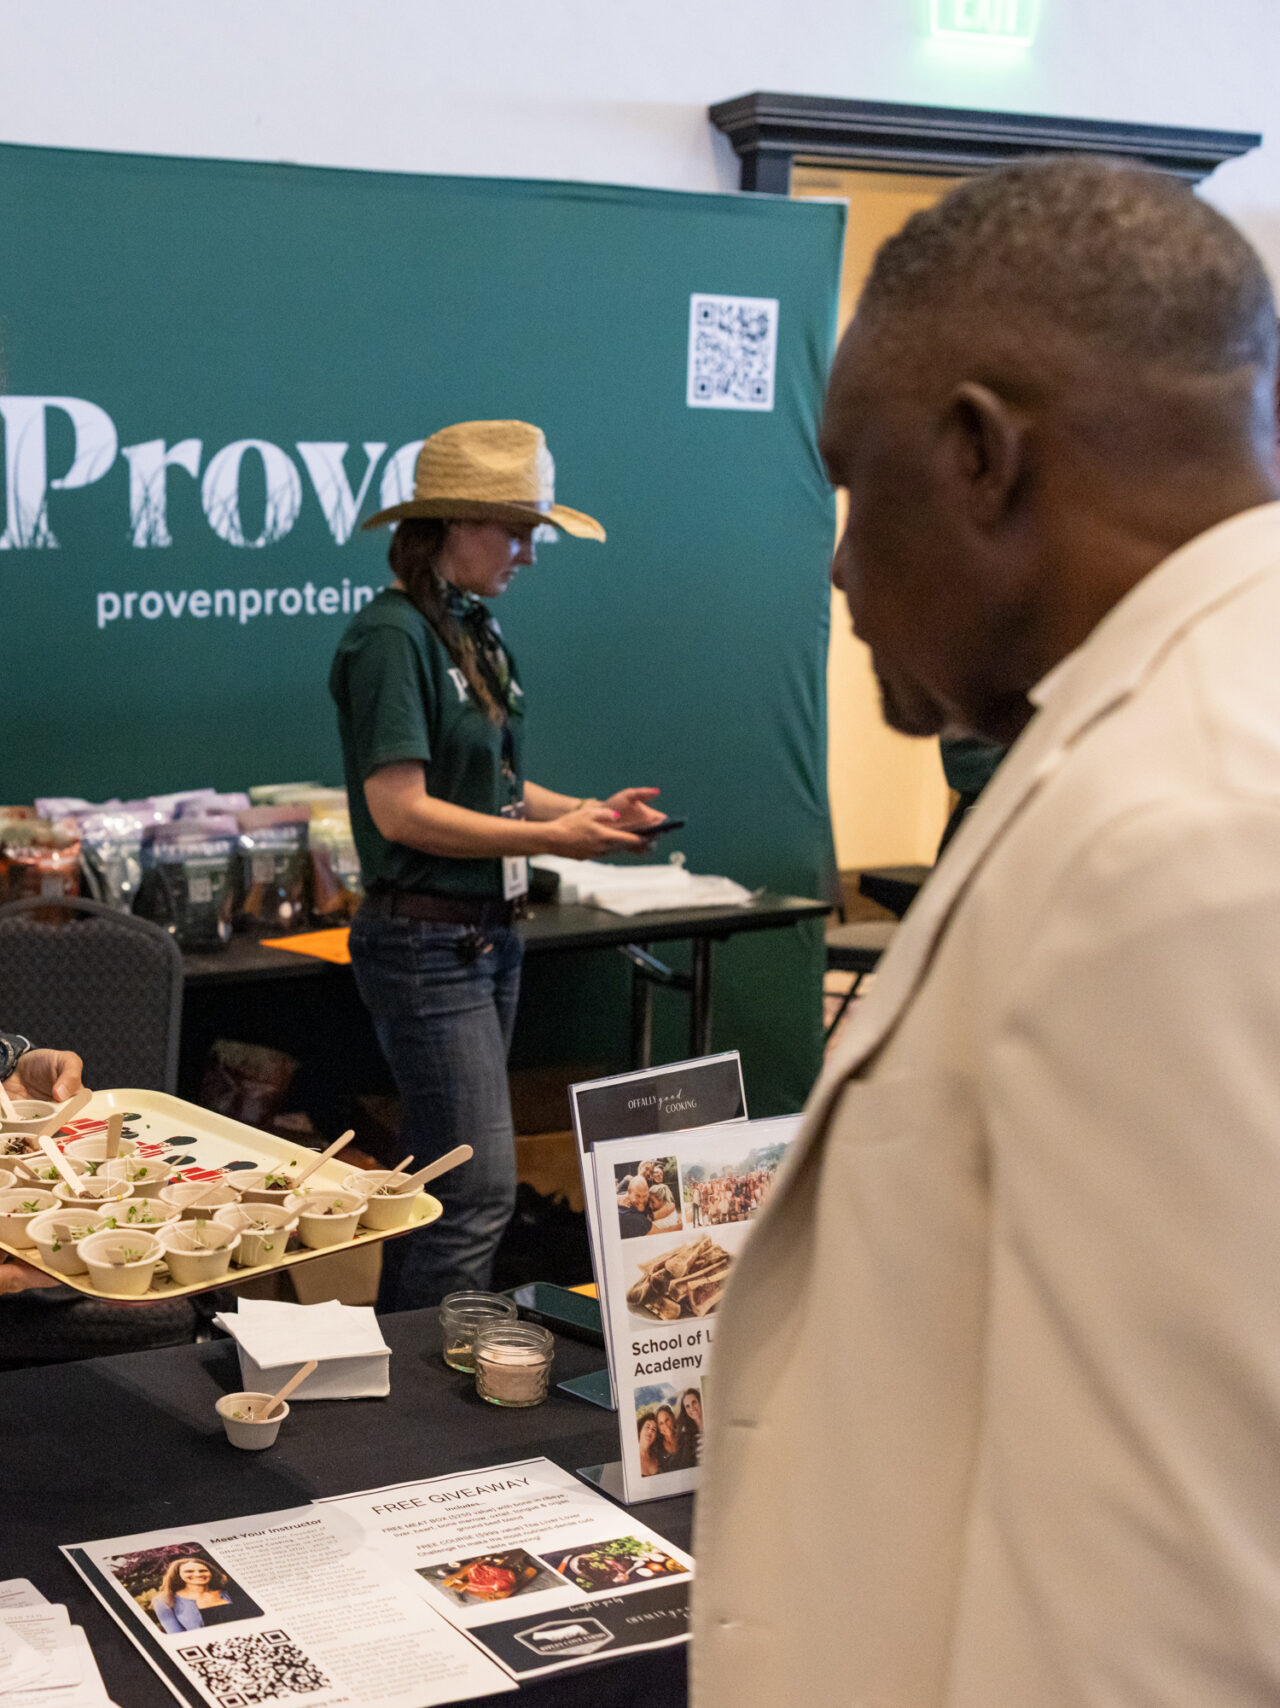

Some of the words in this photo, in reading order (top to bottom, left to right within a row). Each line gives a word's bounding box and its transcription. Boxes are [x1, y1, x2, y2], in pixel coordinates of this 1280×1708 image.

[628, 1096, 657, 1109] OFFALLY
[666, 1099, 697, 1113] COOKING
[632, 1334, 682, 1356] School
[687, 1330, 701, 1346] of
[634, 1354, 702, 1377] Academy
[371, 1497, 427, 1515] FREE
[428, 1477, 532, 1503] GIVEAWAY
[210, 1534, 238, 1545] Meet
[240, 1530, 266, 1538] Your
[268, 1519, 322, 1534] Instructor
